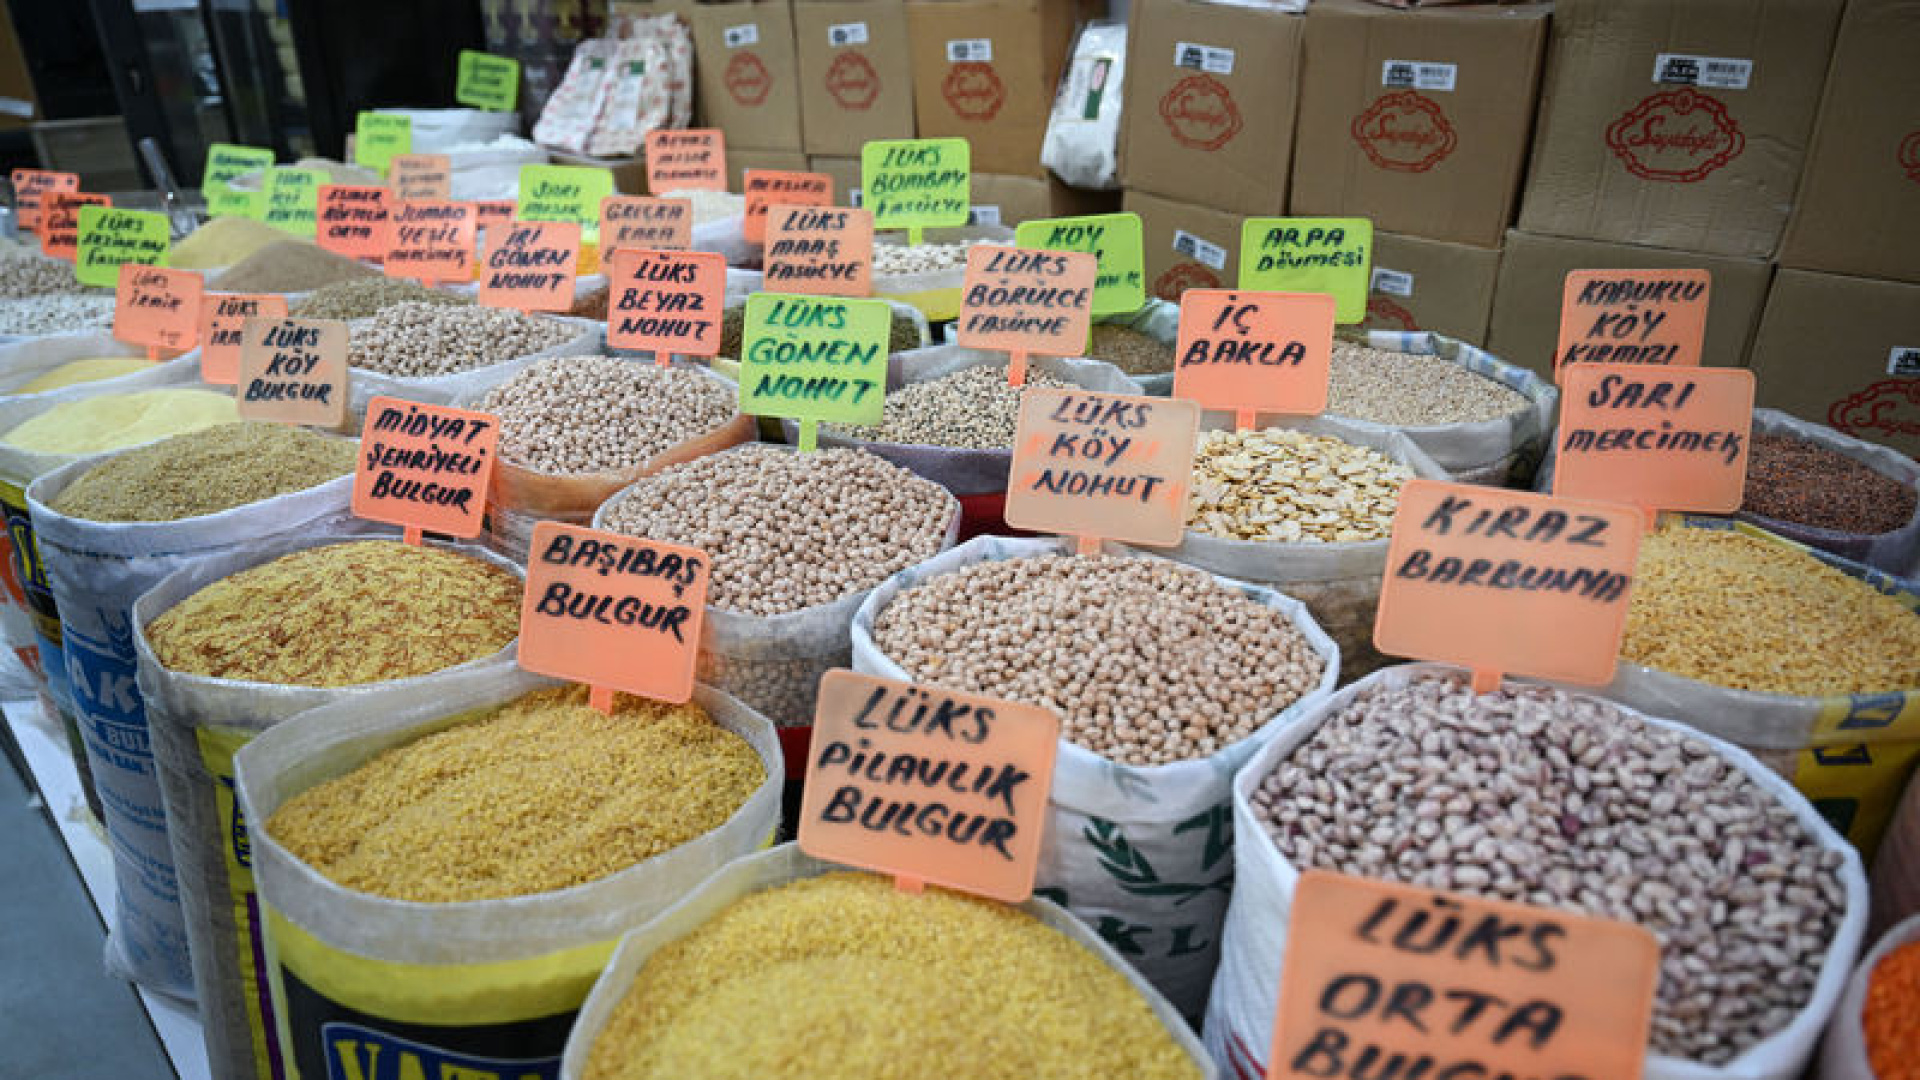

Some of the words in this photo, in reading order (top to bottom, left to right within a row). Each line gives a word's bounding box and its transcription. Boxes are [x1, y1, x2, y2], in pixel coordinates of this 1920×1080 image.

[882, 144, 941, 168] LÜKS
[871, 169, 967, 197] BOMBAY
[393, 205, 467, 222] JUMBO
[781, 208, 849, 232] LÜKS
[1261, 227, 1346, 249] ARPA
[489, 246, 571, 270] GÖNEN
[634, 252, 699, 284] LÜKS
[983, 249, 1069, 277] LÜKS
[487, 272, 569, 291] NOHUT
[966, 278, 1089, 308] BÖRÜLCE
[1577, 279, 1706, 306] KABUKLU
[617, 288, 706, 312] BEYAZ
[764, 299, 847, 330] LÜKS
[1211, 294, 1261, 337] İÇ
[262, 320, 321, 347] LÜKS
[616, 318, 714, 341] NOHUT
[1586, 305, 1667, 341] KÖY
[264, 347, 321, 376] KÖY
[749, 333, 880, 368] GÖNEN
[1179, 339, 1308, 368] BAKLA
[1561, 343, 1681, 365] KIRMIZI
[244, 377, 333, 406] BULGUR
[753, 373, 878, 405] NOHUT
[1587, 373, 1696, 410] SARI
[373, 405, 491, 446] MİDYAT
[1048, 394, 1154, 430] LÜKS
[366, 442, 486, 476] ŞEHRİYELİ
[1048, 429, 1132, 467] KÖY
[1563, 420, 1744, 466] MERCİMEK
[371, 470, 474, 516] BULGUR
[1031, 469, 1165, 502] NOHUT
[1421, 494, 1612, 550] KIRAZ
[541, 534, 704, 598] BAŞIBAŞ
[1396, 548, 1632, 605] BARBUNYA
[535, 581, 692, 644] BULGUR
[853, 685, 997, 745] LÜKS
[817, 738, 1031, 816] PİLAVLIK
[821, 785, 1020, 862] BULGUR
[1353, 896, 1568, 973] LÜKS
[1318, 972, 1566, 1050] ORTA
